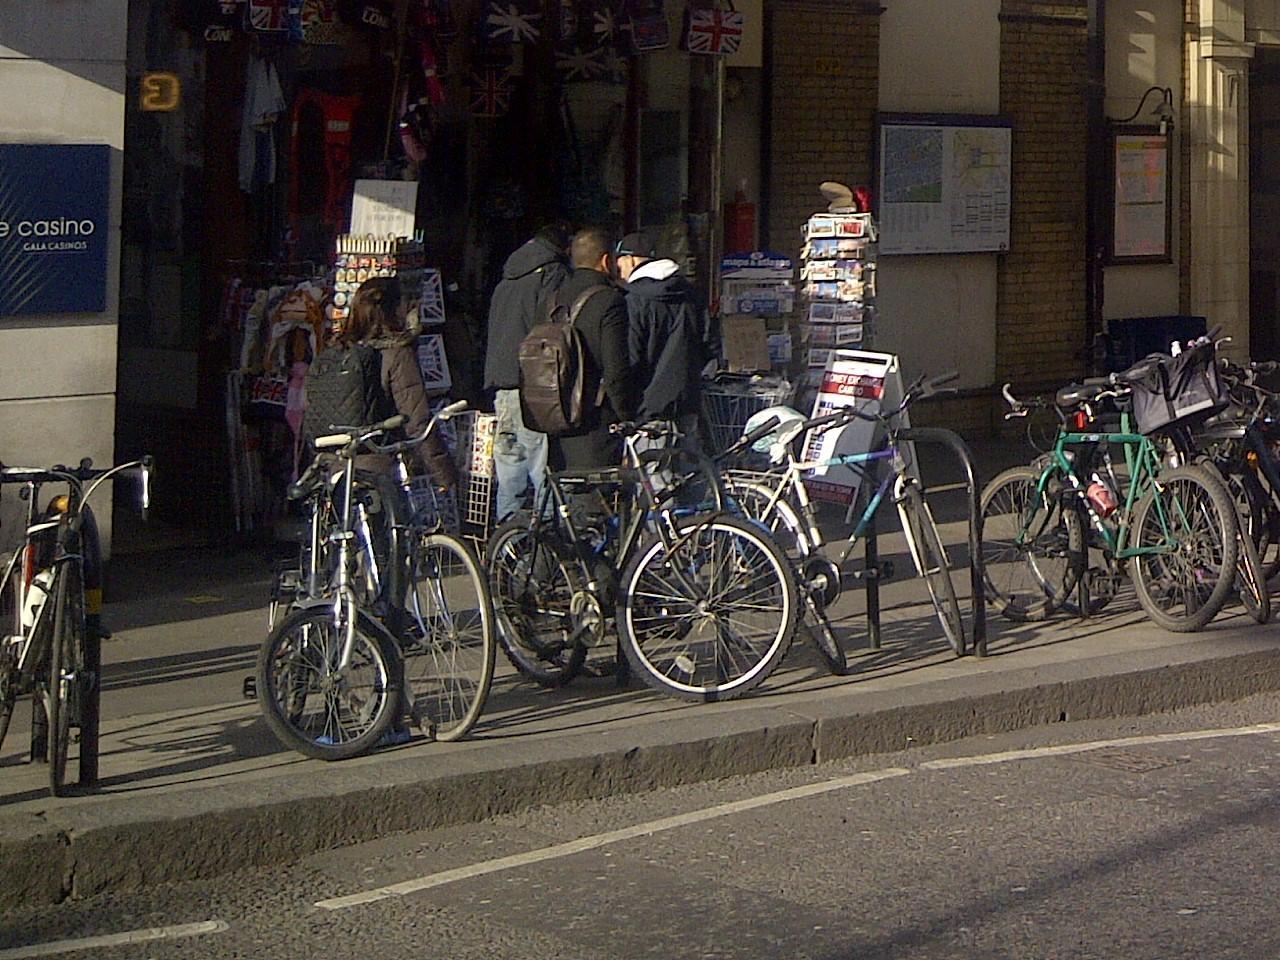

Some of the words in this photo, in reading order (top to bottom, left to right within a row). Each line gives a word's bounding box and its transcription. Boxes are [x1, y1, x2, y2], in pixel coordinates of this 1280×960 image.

[18, 216, 95, 236] casino
[23, 242, 47, 252] GALA
[48, 241, 87, 251] CASINOS
